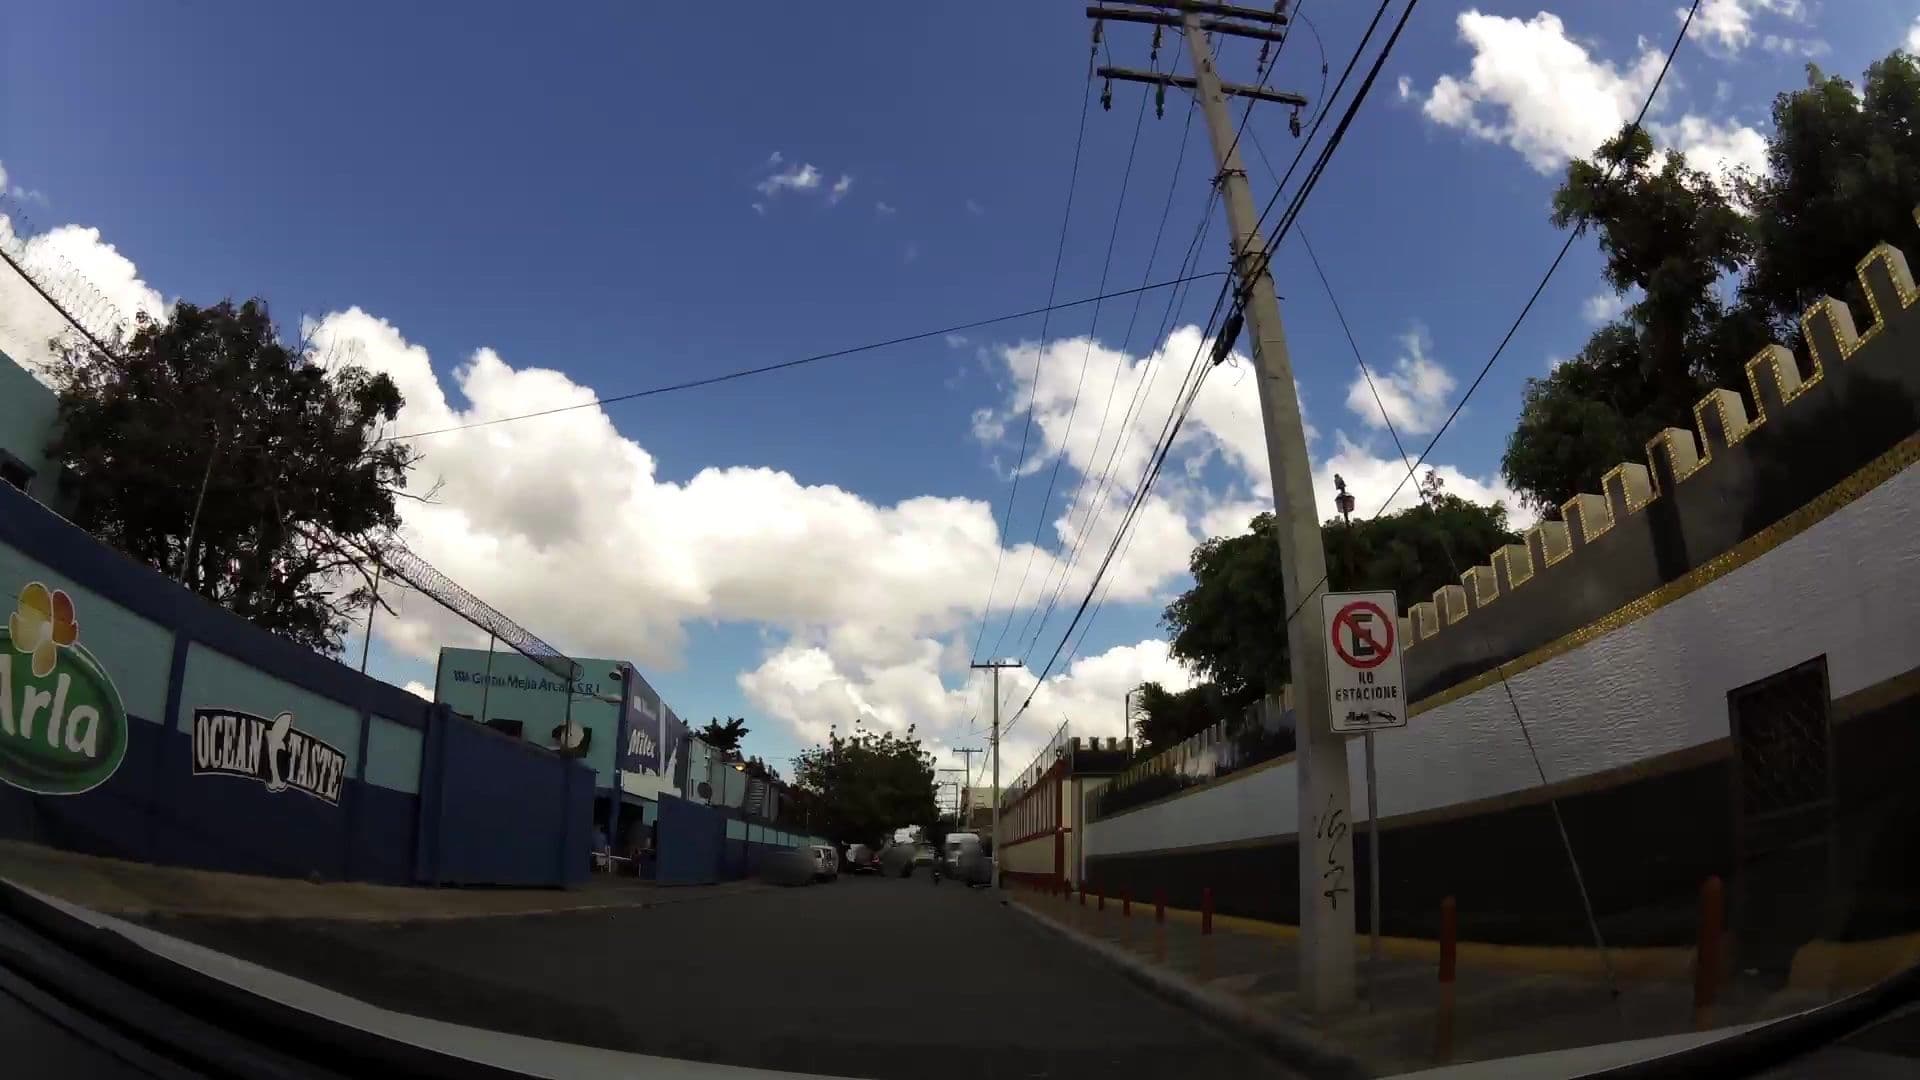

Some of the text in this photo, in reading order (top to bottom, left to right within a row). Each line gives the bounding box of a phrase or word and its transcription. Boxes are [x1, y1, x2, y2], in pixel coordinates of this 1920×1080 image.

[1358, 671, 1373, 685] NO
[1336, 686, 1397, 702] ESTACIONE
[196, 715, 344, 801] OCEAN TASTE
